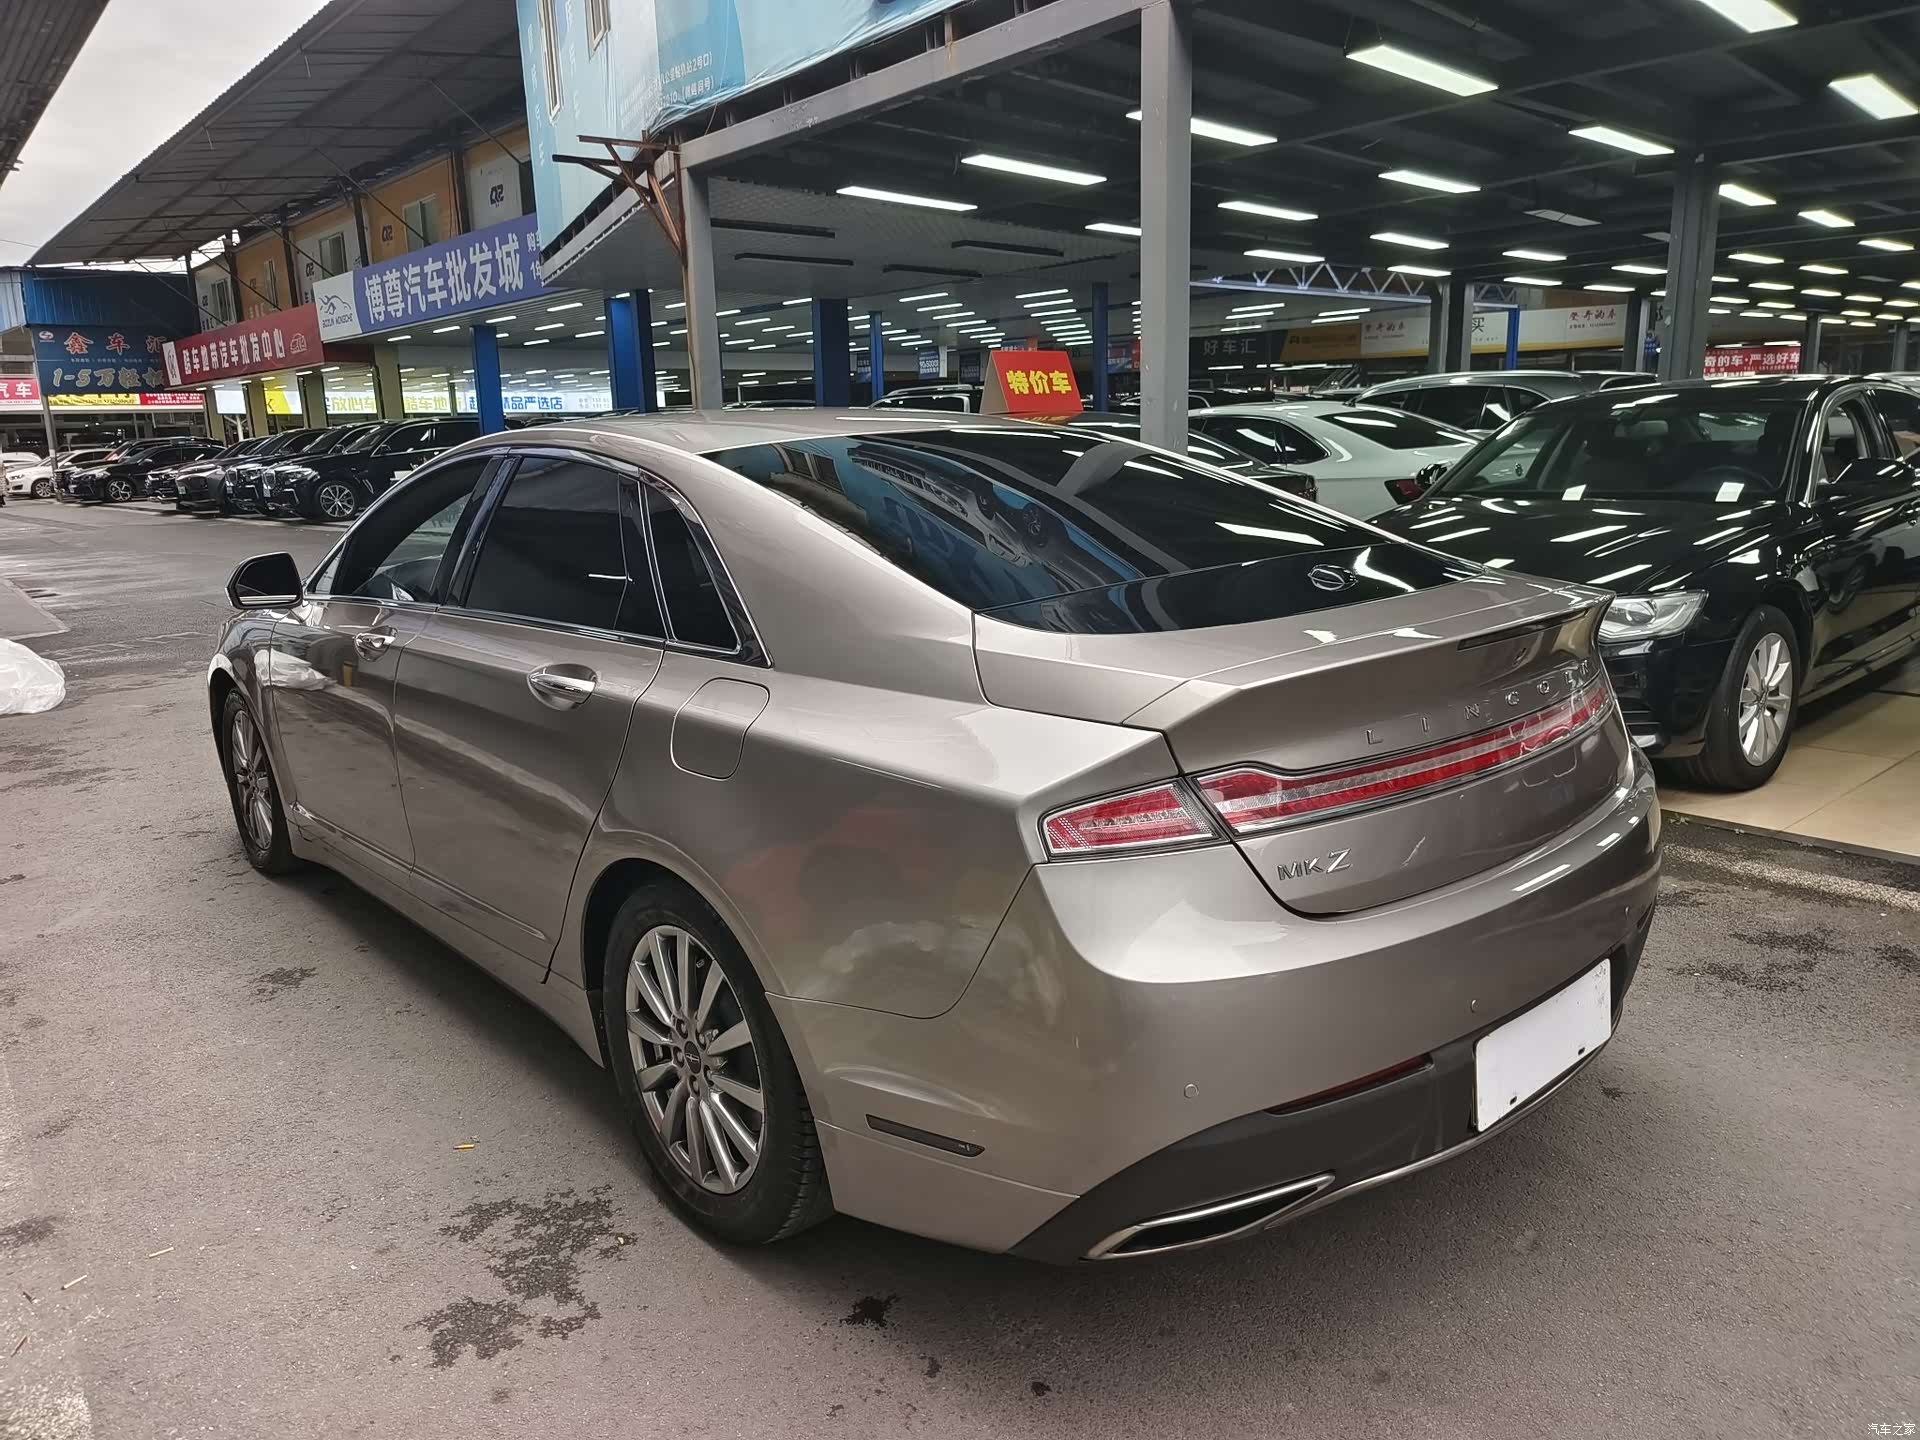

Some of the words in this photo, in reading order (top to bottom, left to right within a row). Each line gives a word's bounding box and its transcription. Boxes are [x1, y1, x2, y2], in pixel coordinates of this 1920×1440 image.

[364, 233, 524, 325] 博尊汽车批发城
[1204, 337, 1257, 356] 好车汇
[1006, 369, 1073, 396] 特价车
[1364, 659, 1591, 746] LINCOLN
[1276, 847, 1353, 882] MKZ
